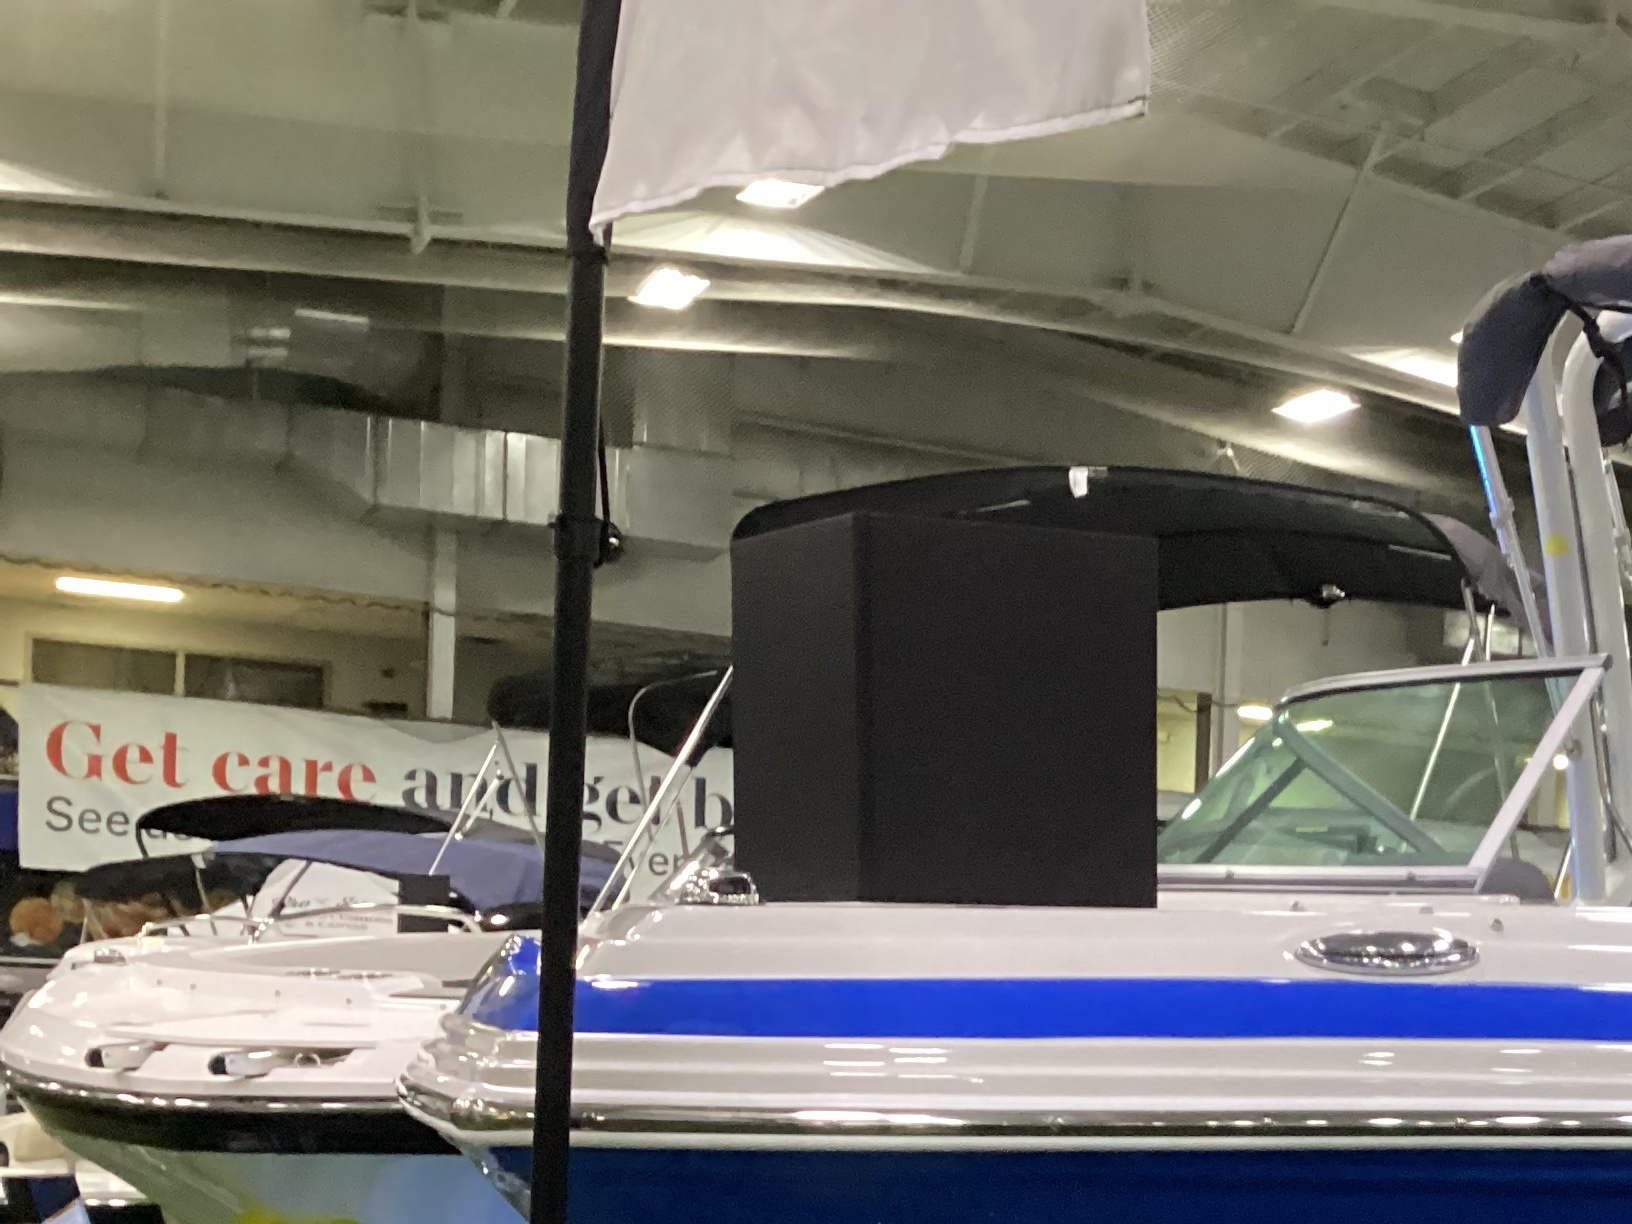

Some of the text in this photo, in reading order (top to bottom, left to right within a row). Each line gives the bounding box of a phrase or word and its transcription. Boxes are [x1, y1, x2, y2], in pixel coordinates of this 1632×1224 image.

[46, 720, 187, 788] Get
[211, 751, 377, 804] care
[401, 762, 540, 820] and
[45, 795, 131, 837] See
